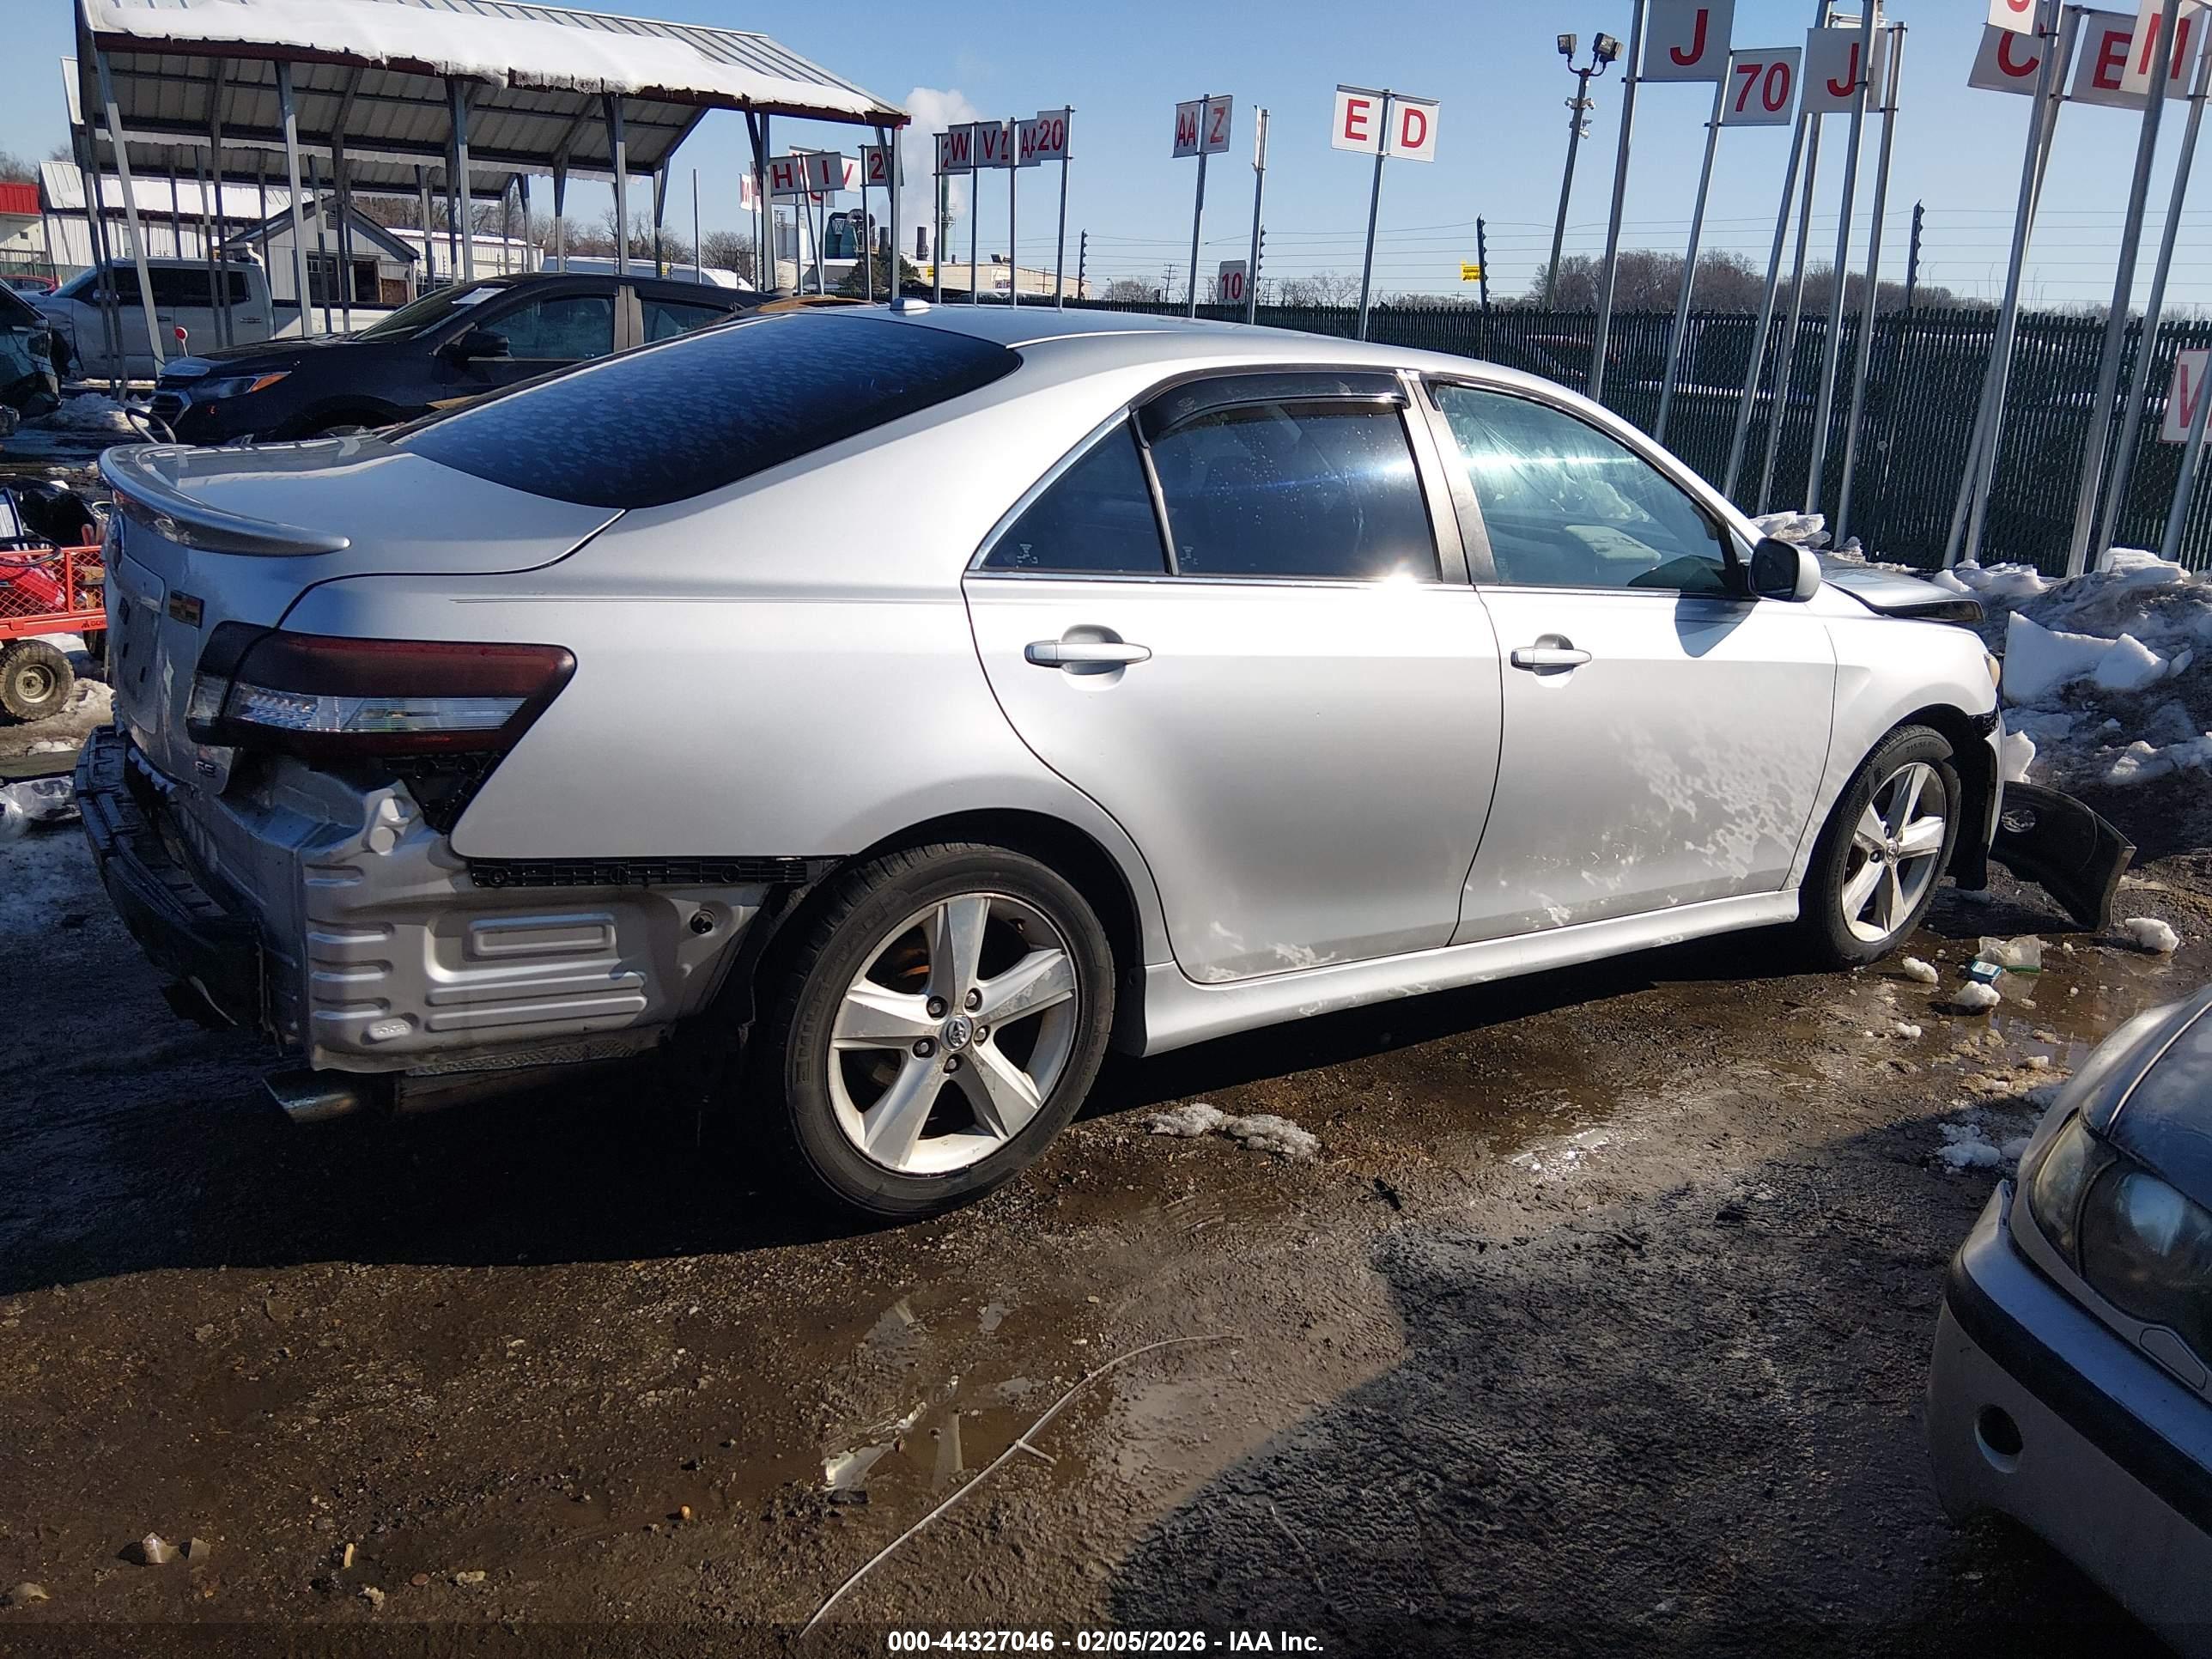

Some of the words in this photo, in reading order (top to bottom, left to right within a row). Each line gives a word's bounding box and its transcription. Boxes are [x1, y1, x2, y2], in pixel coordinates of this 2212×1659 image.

[1670, 9, 1709, 66] J
[1735, 62, 1790, 112] 70
[1826, 42, 1859, 97] J
[1037, 118, 1064, 151] 20
[1176, 111, 1196, 148] AA
[1210, 106, 1226, 143] Z
[1345, 99, 1370, 141] E
[1401, 107, 1427, 149] D
[950, 132, 970, 161] W
[982, 130, 997, 160] V
[772, 163, 793, 189] H
[1221, 272, 1243, 300] 10
